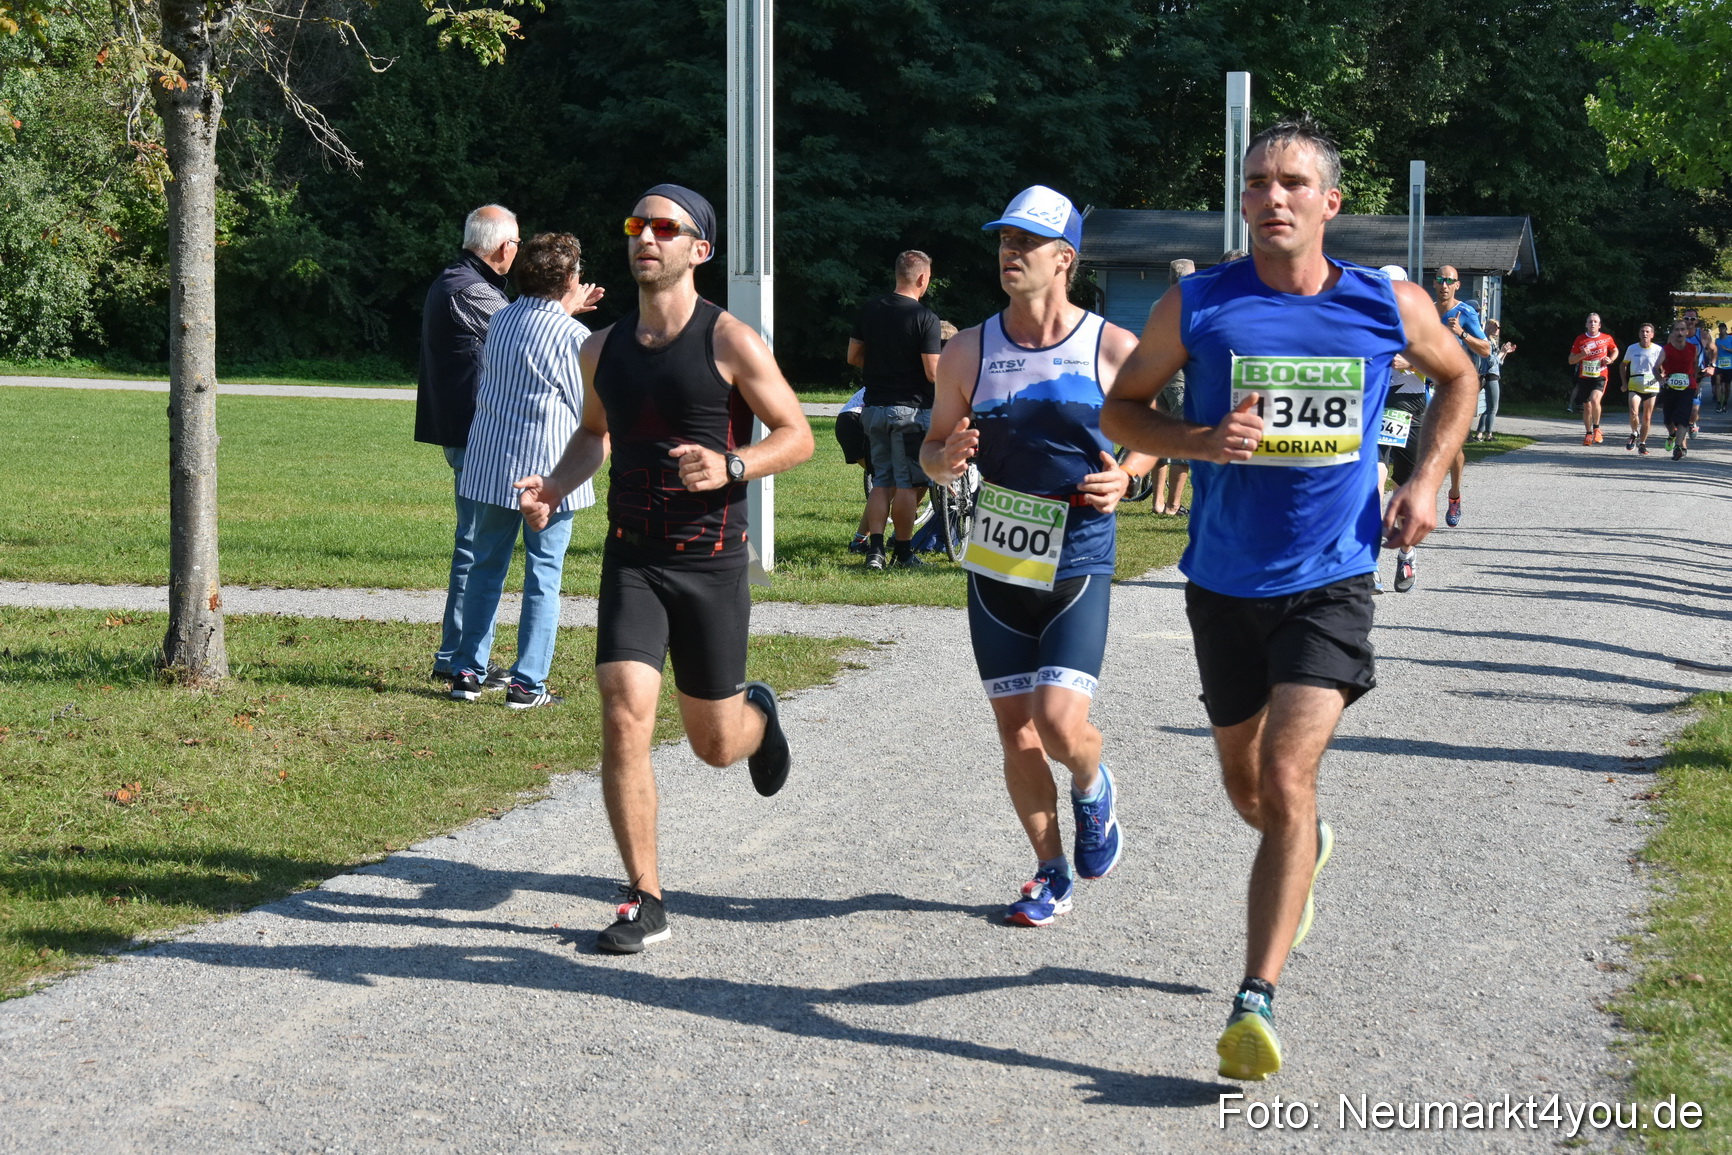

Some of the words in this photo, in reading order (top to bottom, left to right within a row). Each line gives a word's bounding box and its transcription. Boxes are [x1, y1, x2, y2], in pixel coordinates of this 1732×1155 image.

[988, 358, 1026, 370] ATSV
[1243, 363, 1351, 385] BOCK
[1257, 396, 1347, 428] 1348
[1380, 420, 1404, 435] 547
[983, 488, 1054, 522] BOCK
[981, 516, 1050, 557] 1400
[993, 676, 1032, 691] ATSV
[1037, 670, 1063, 680] TSV
[1073, 675, 1098, 690] ATS
